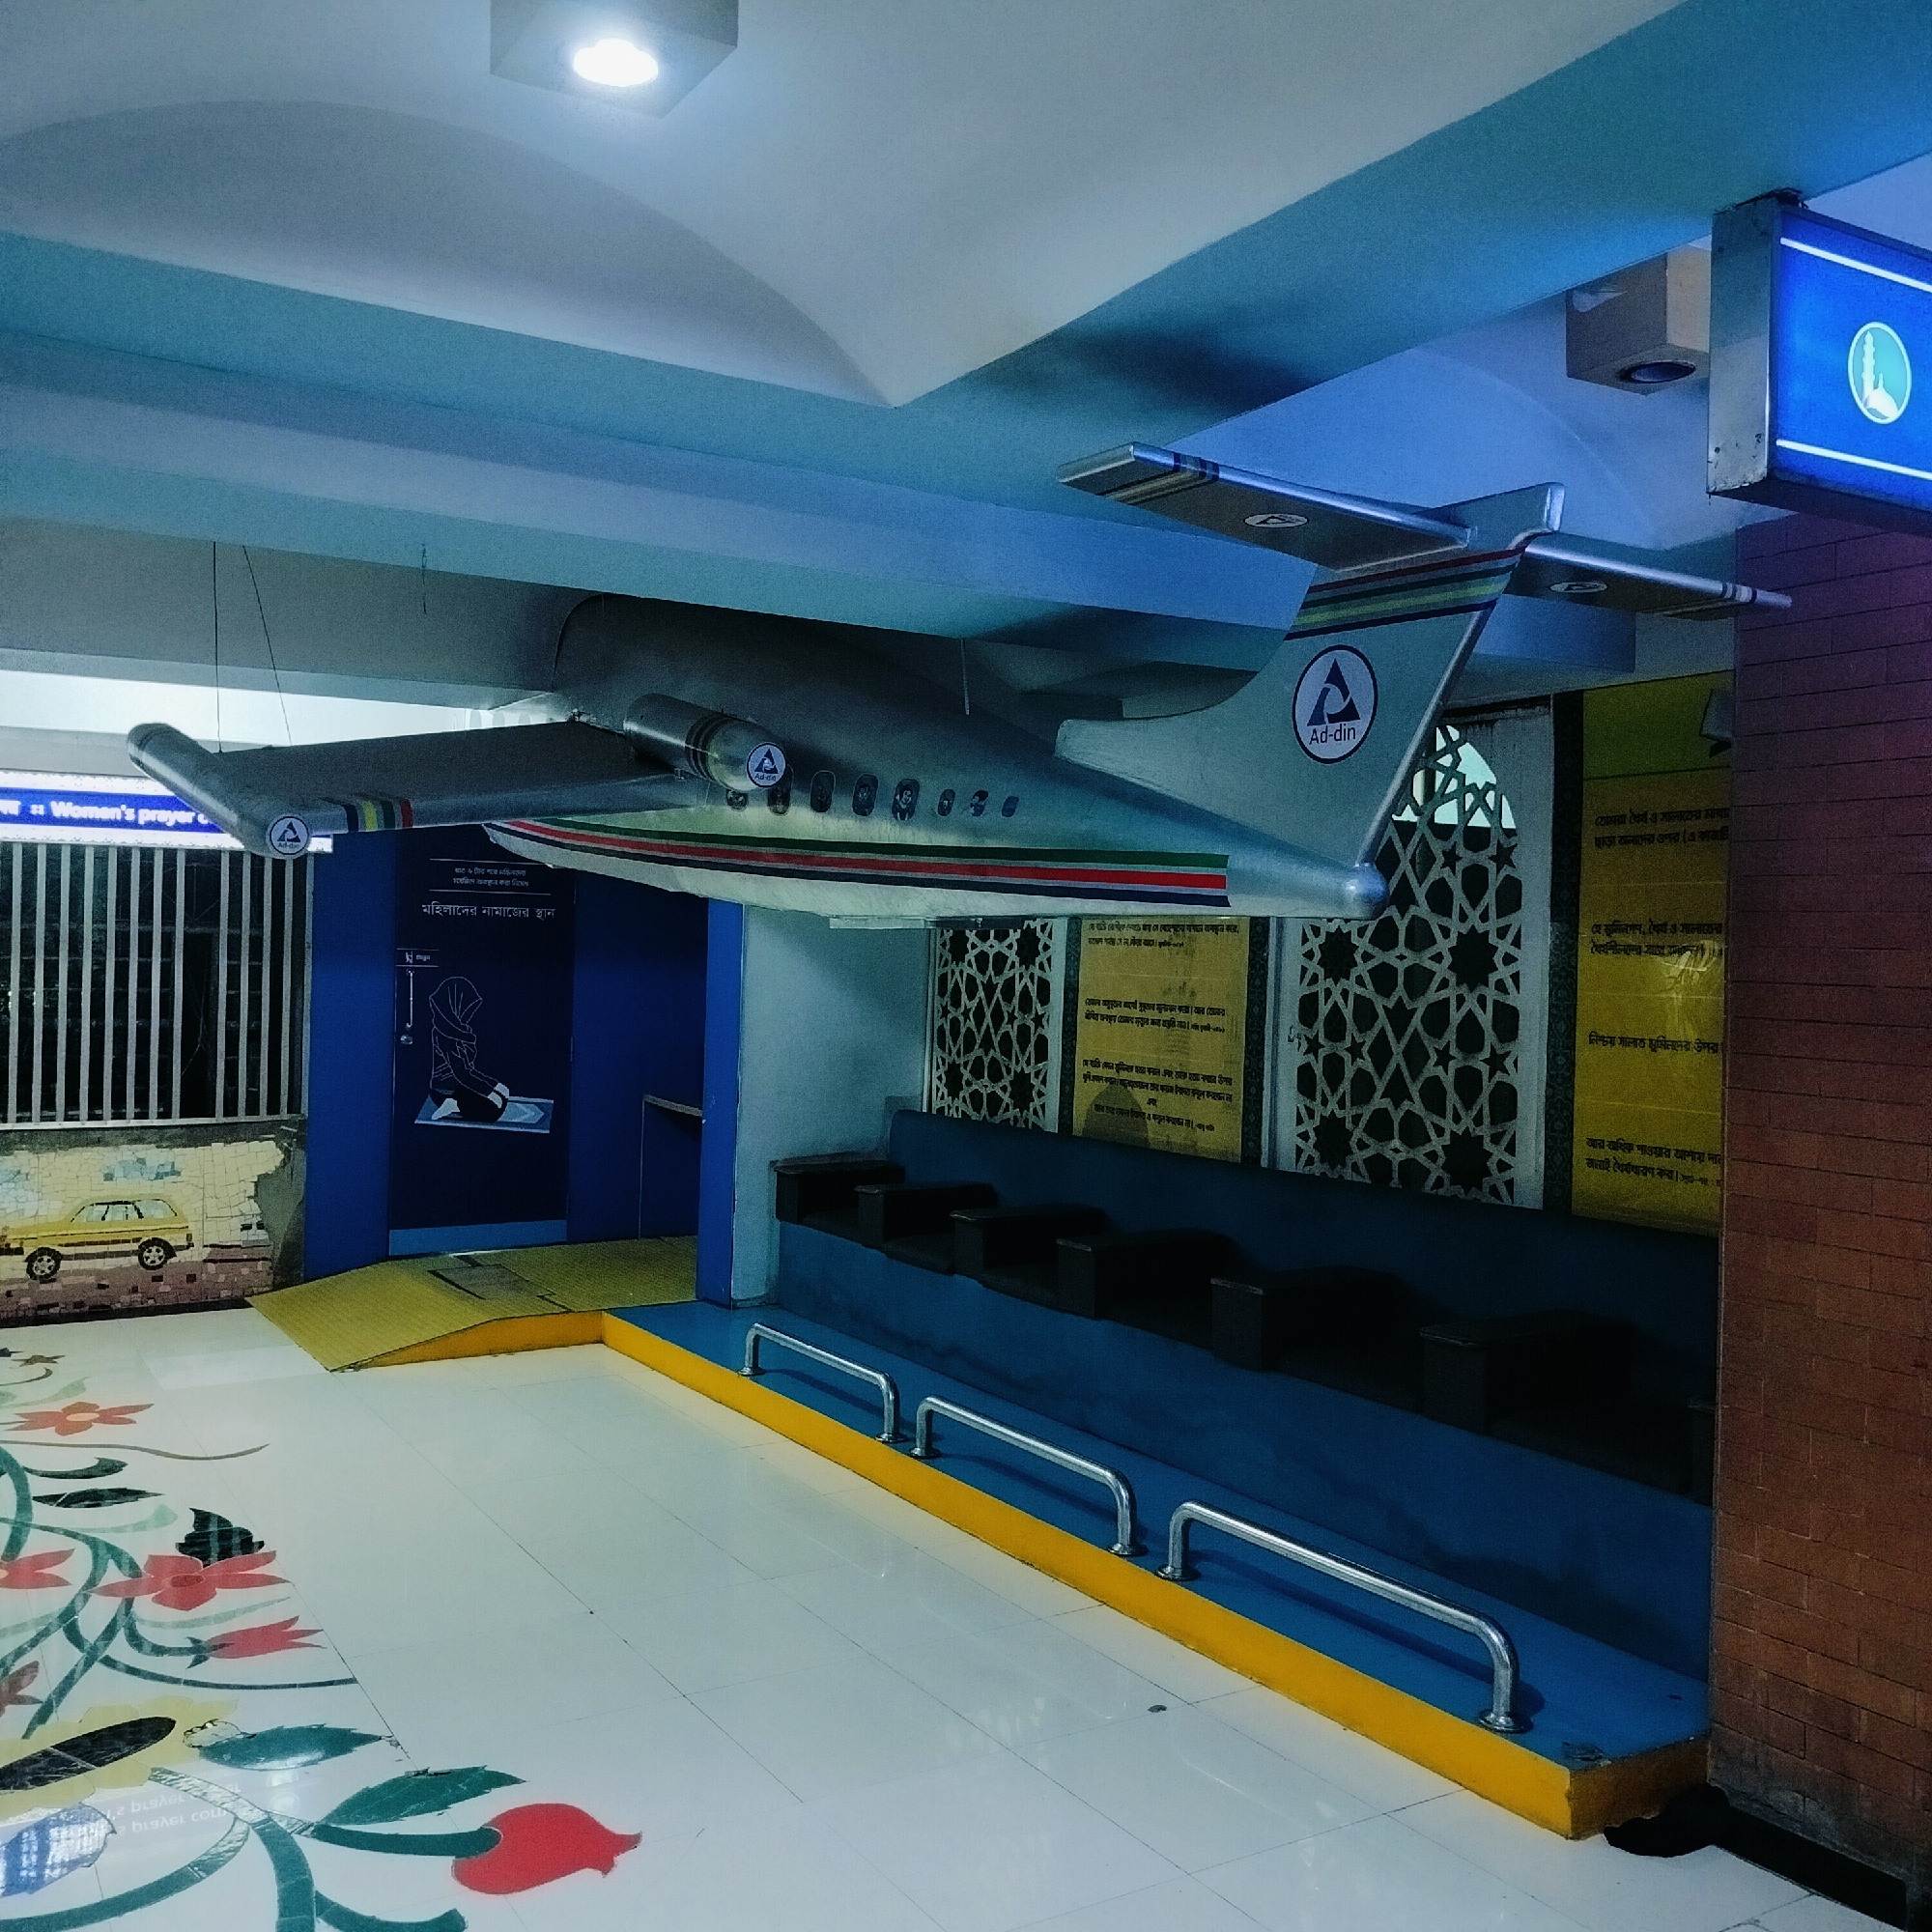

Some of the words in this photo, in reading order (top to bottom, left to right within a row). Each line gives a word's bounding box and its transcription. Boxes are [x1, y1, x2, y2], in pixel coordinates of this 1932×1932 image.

[1309, 724, 1356, 745] Ad-din
[754, 773, 777, 781] Ad-din
[50, 801, 135, 820] Women's
[138, 809, 195, 827] prayer
[421, 900, 477, 917] মহিলাদের
[481, 905, 530, 919] নামাজের
[534, 907, 556, 921] স্থান
